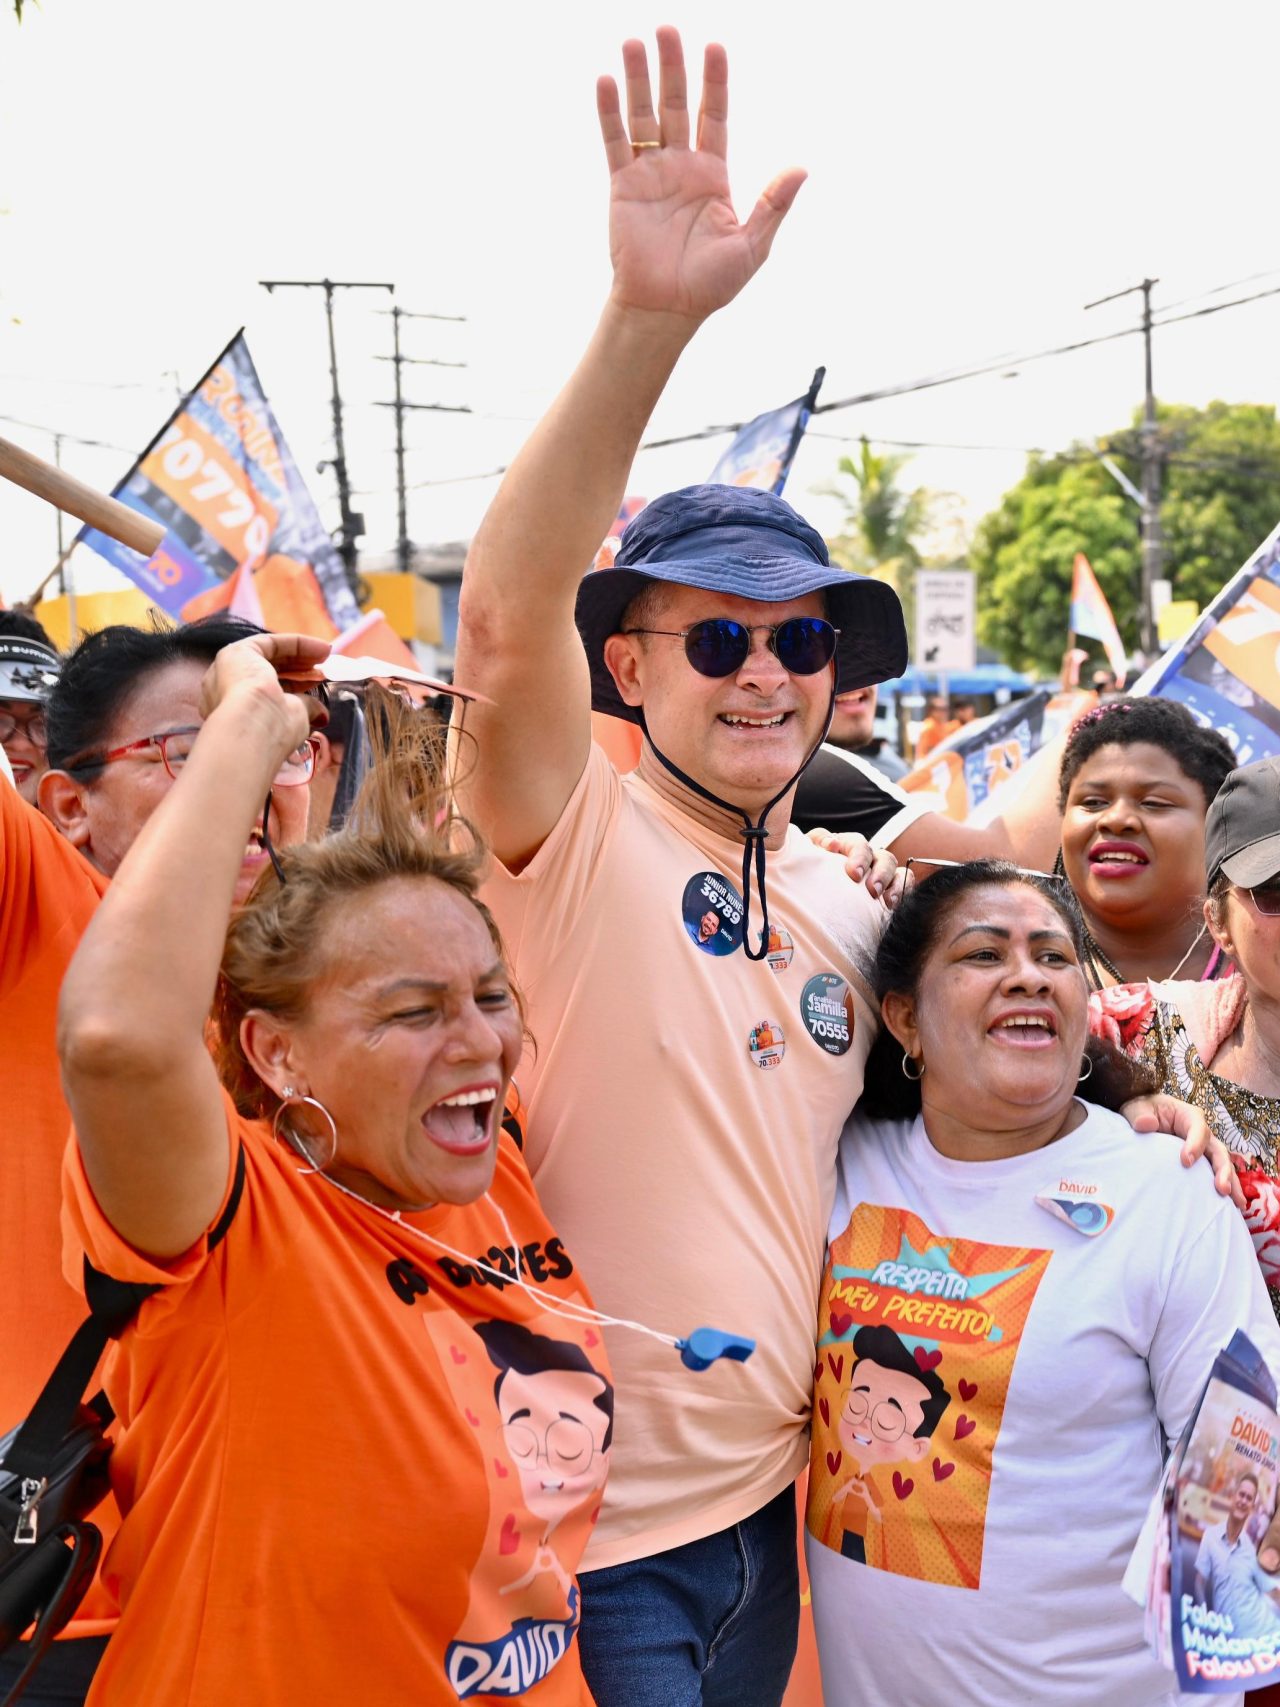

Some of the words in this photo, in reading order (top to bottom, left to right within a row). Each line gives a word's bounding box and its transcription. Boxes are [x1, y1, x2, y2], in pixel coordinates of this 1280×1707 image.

[700, 882, 741, 925] 36789
[704, 874, 727, 898] JUNIOR
[808, 1018, 850, 1041] 70555
[759, 1056, 781, 1068] 70.333
[1058, 1180, 1099, 1195] DAVID
[871, 1260, 970, 1300] RESPEITA
[829, 1279, 880, 1313] MEU
[881, 1294, 996, 1342] PREFEITO!
[1231, 1414, 1270, 1454] DAVID
[1180, 1592, 1234, 1634] Falou
[449, 1622, 567, 1697] DAVID
[1185, 1650, 1256, 1681] Falou
